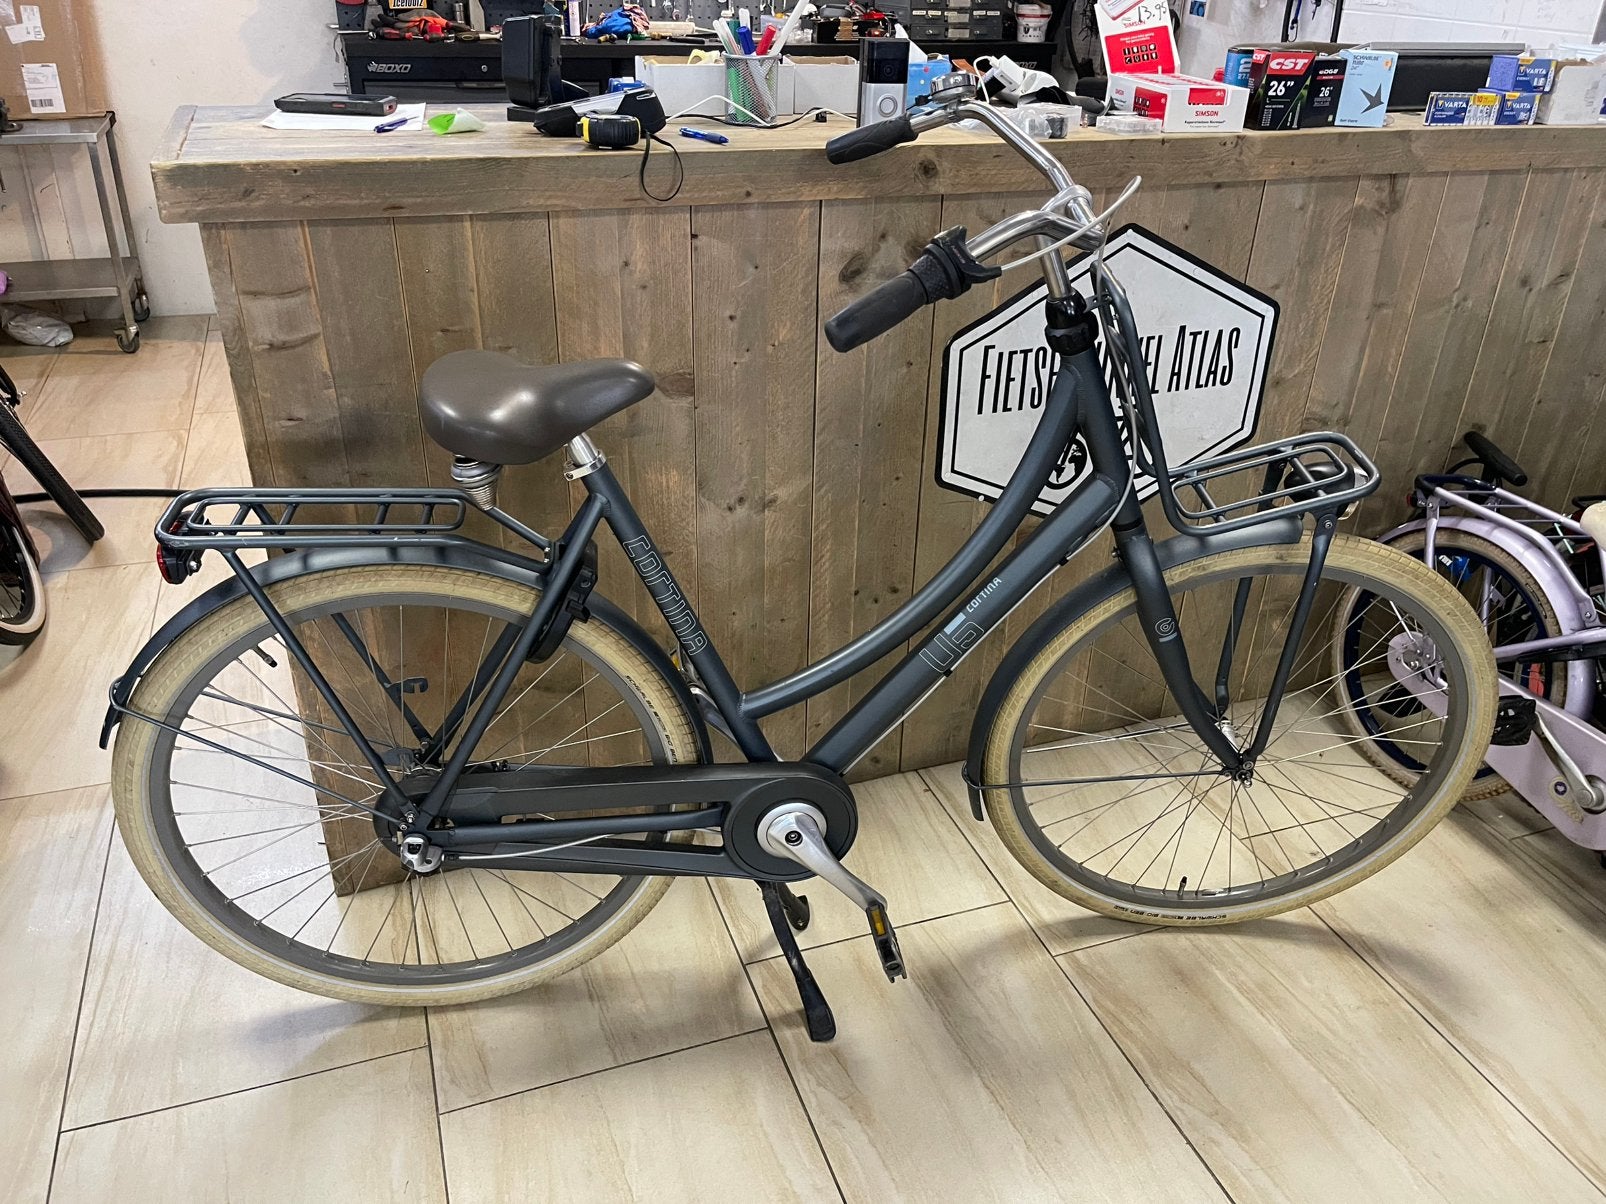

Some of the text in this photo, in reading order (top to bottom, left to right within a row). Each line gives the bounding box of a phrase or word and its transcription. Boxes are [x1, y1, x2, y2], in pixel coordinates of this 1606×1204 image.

[376, 63, 412, 73] BOXO
[1269, 57, 1309, 71] CST
[966, 577, 1003, 613] CORTINA
